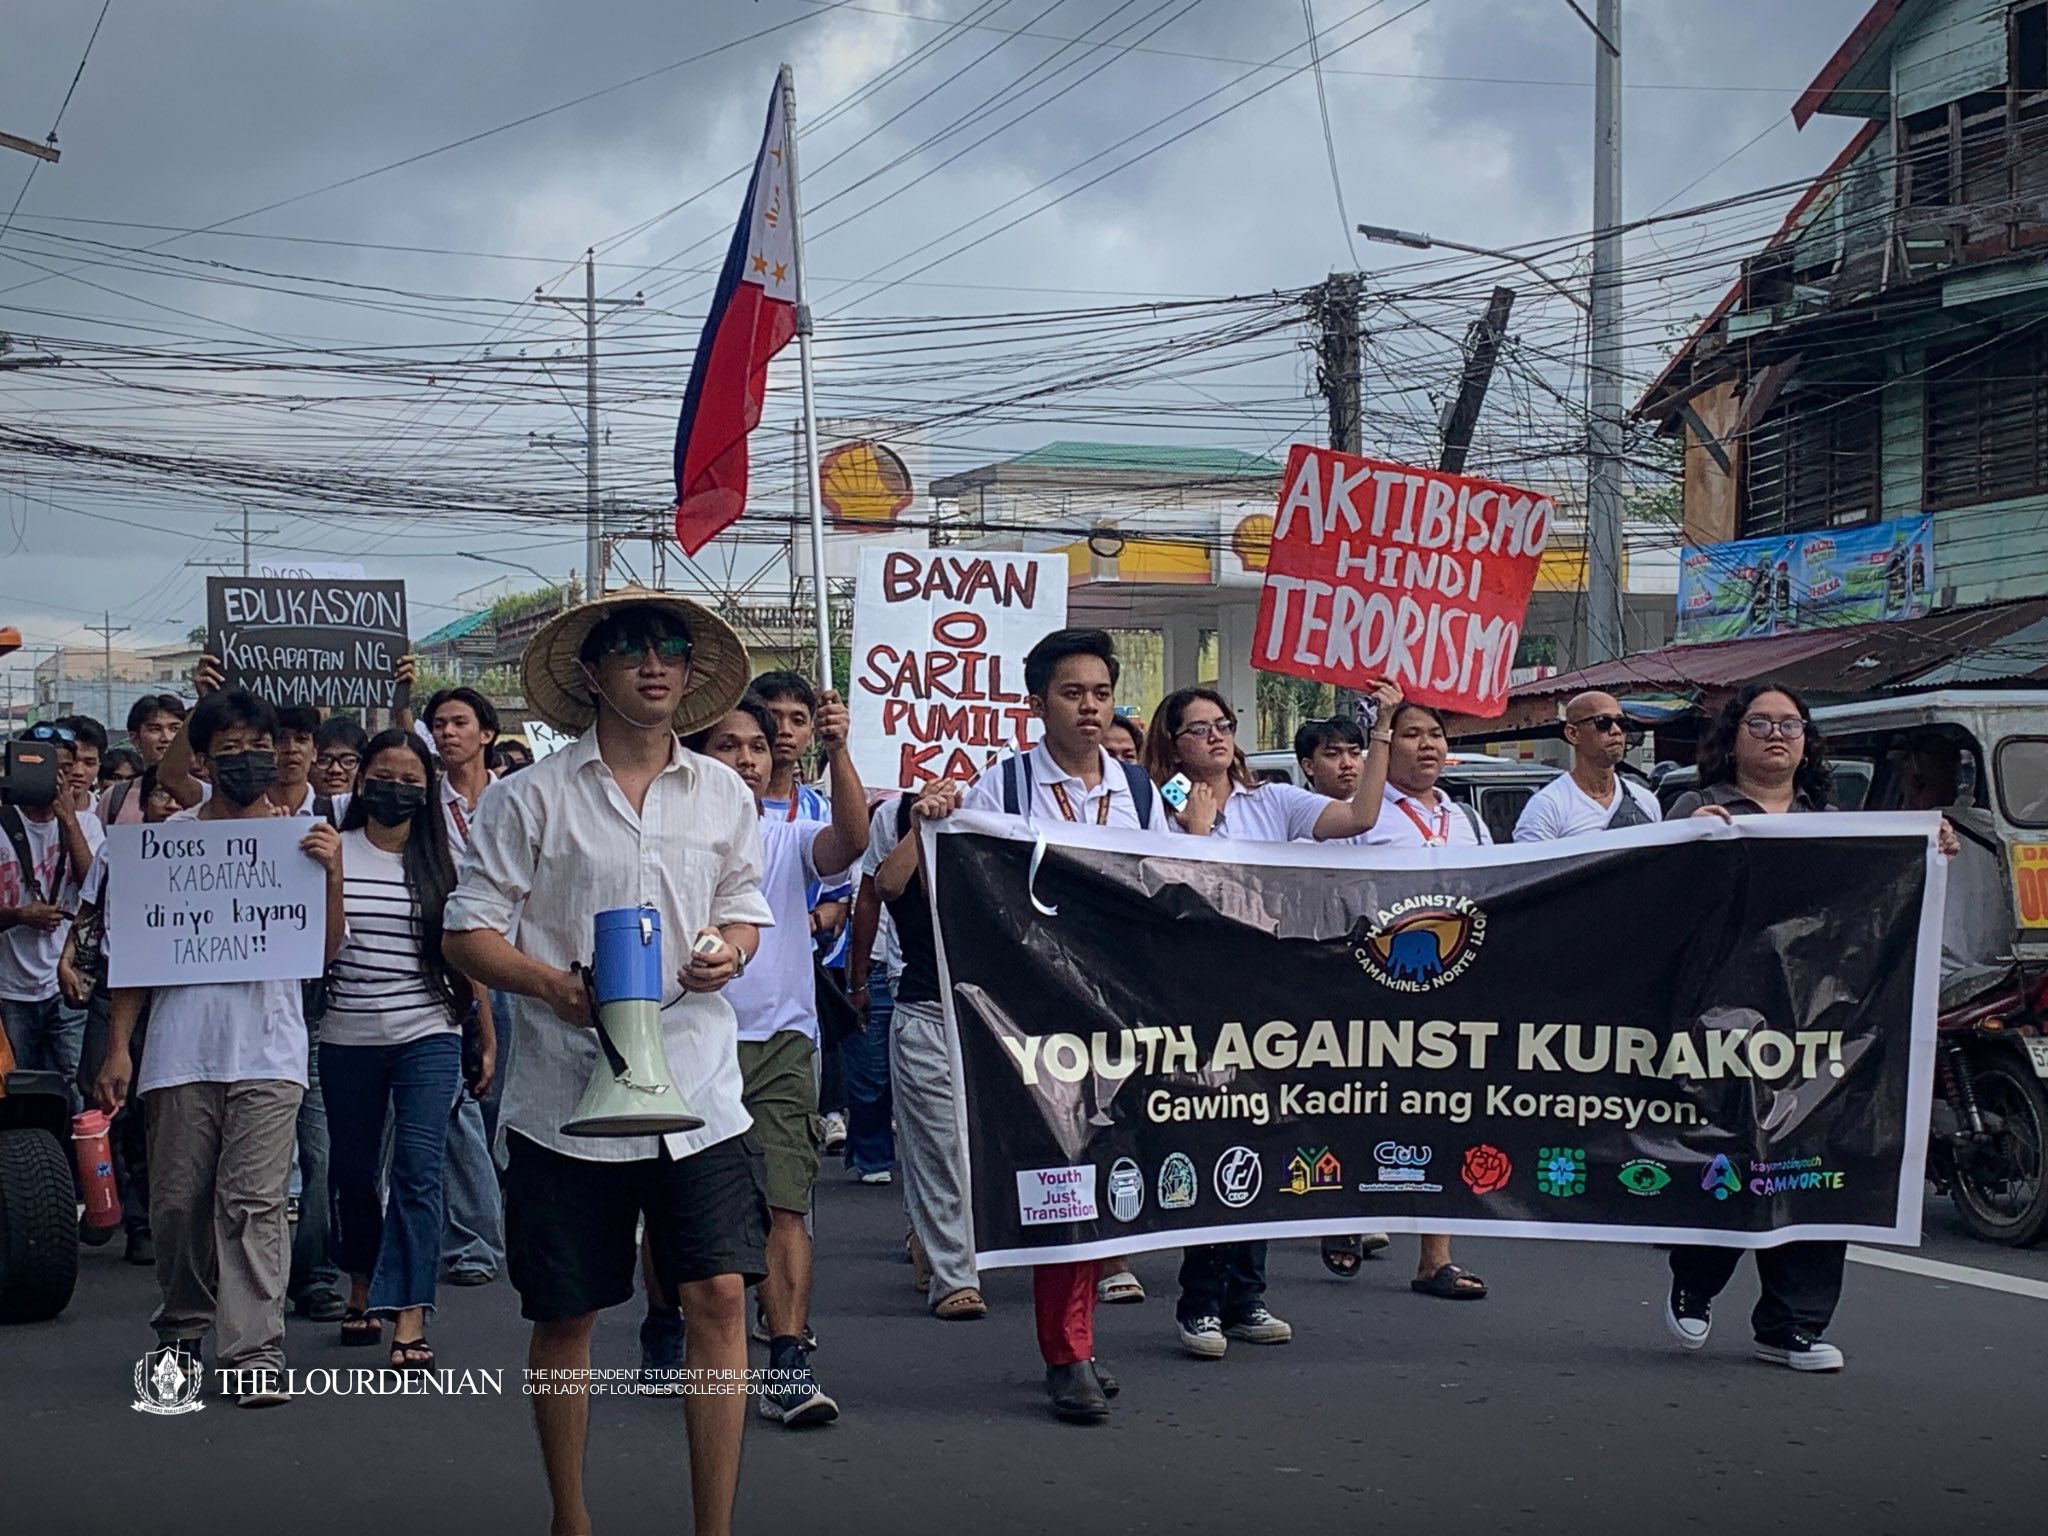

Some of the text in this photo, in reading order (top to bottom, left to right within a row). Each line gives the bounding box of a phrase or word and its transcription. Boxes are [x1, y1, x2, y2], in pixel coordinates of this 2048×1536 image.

[1275, 453, 1554, 558] AKTIBISMO
[884, 552, 1038, 609] BAYAN
[1336, 540, 1482, 601] HINDI
[223, 588, 400, 628] EDUKASYON
[933, 612, 987, 648] O
[1266, 574, 1519, 703] TERORISMO
[219, 630, 392, 672] KARAPATAN NG
[858, 644, 1030, 704] SARIL
[898, 743, 998, 789] KA
[141, 829, 258, 867] Boses ng
[233, 898, 307, 931] kayang
[1377, 895, 1456, 926] AGAINST
[173, 934, 267, 964] TAKPAN!!
[1354, 948, 1477, 993] CAMARINES NORTE
[1003, 1020, 1845, 1085] YOUTH AGAINST KURAKOT!
[1147, 1082, 1709, 1130] Gawing Kadiri ang Korapsyon.
[1037, 1169, 1082, 1186] Youth
[1042, 1190, 1076, 1205] Just
[1750, 1171, 1845, 1196] CAMNORTE
[1023, 1200, 1094, 1221] Transition
